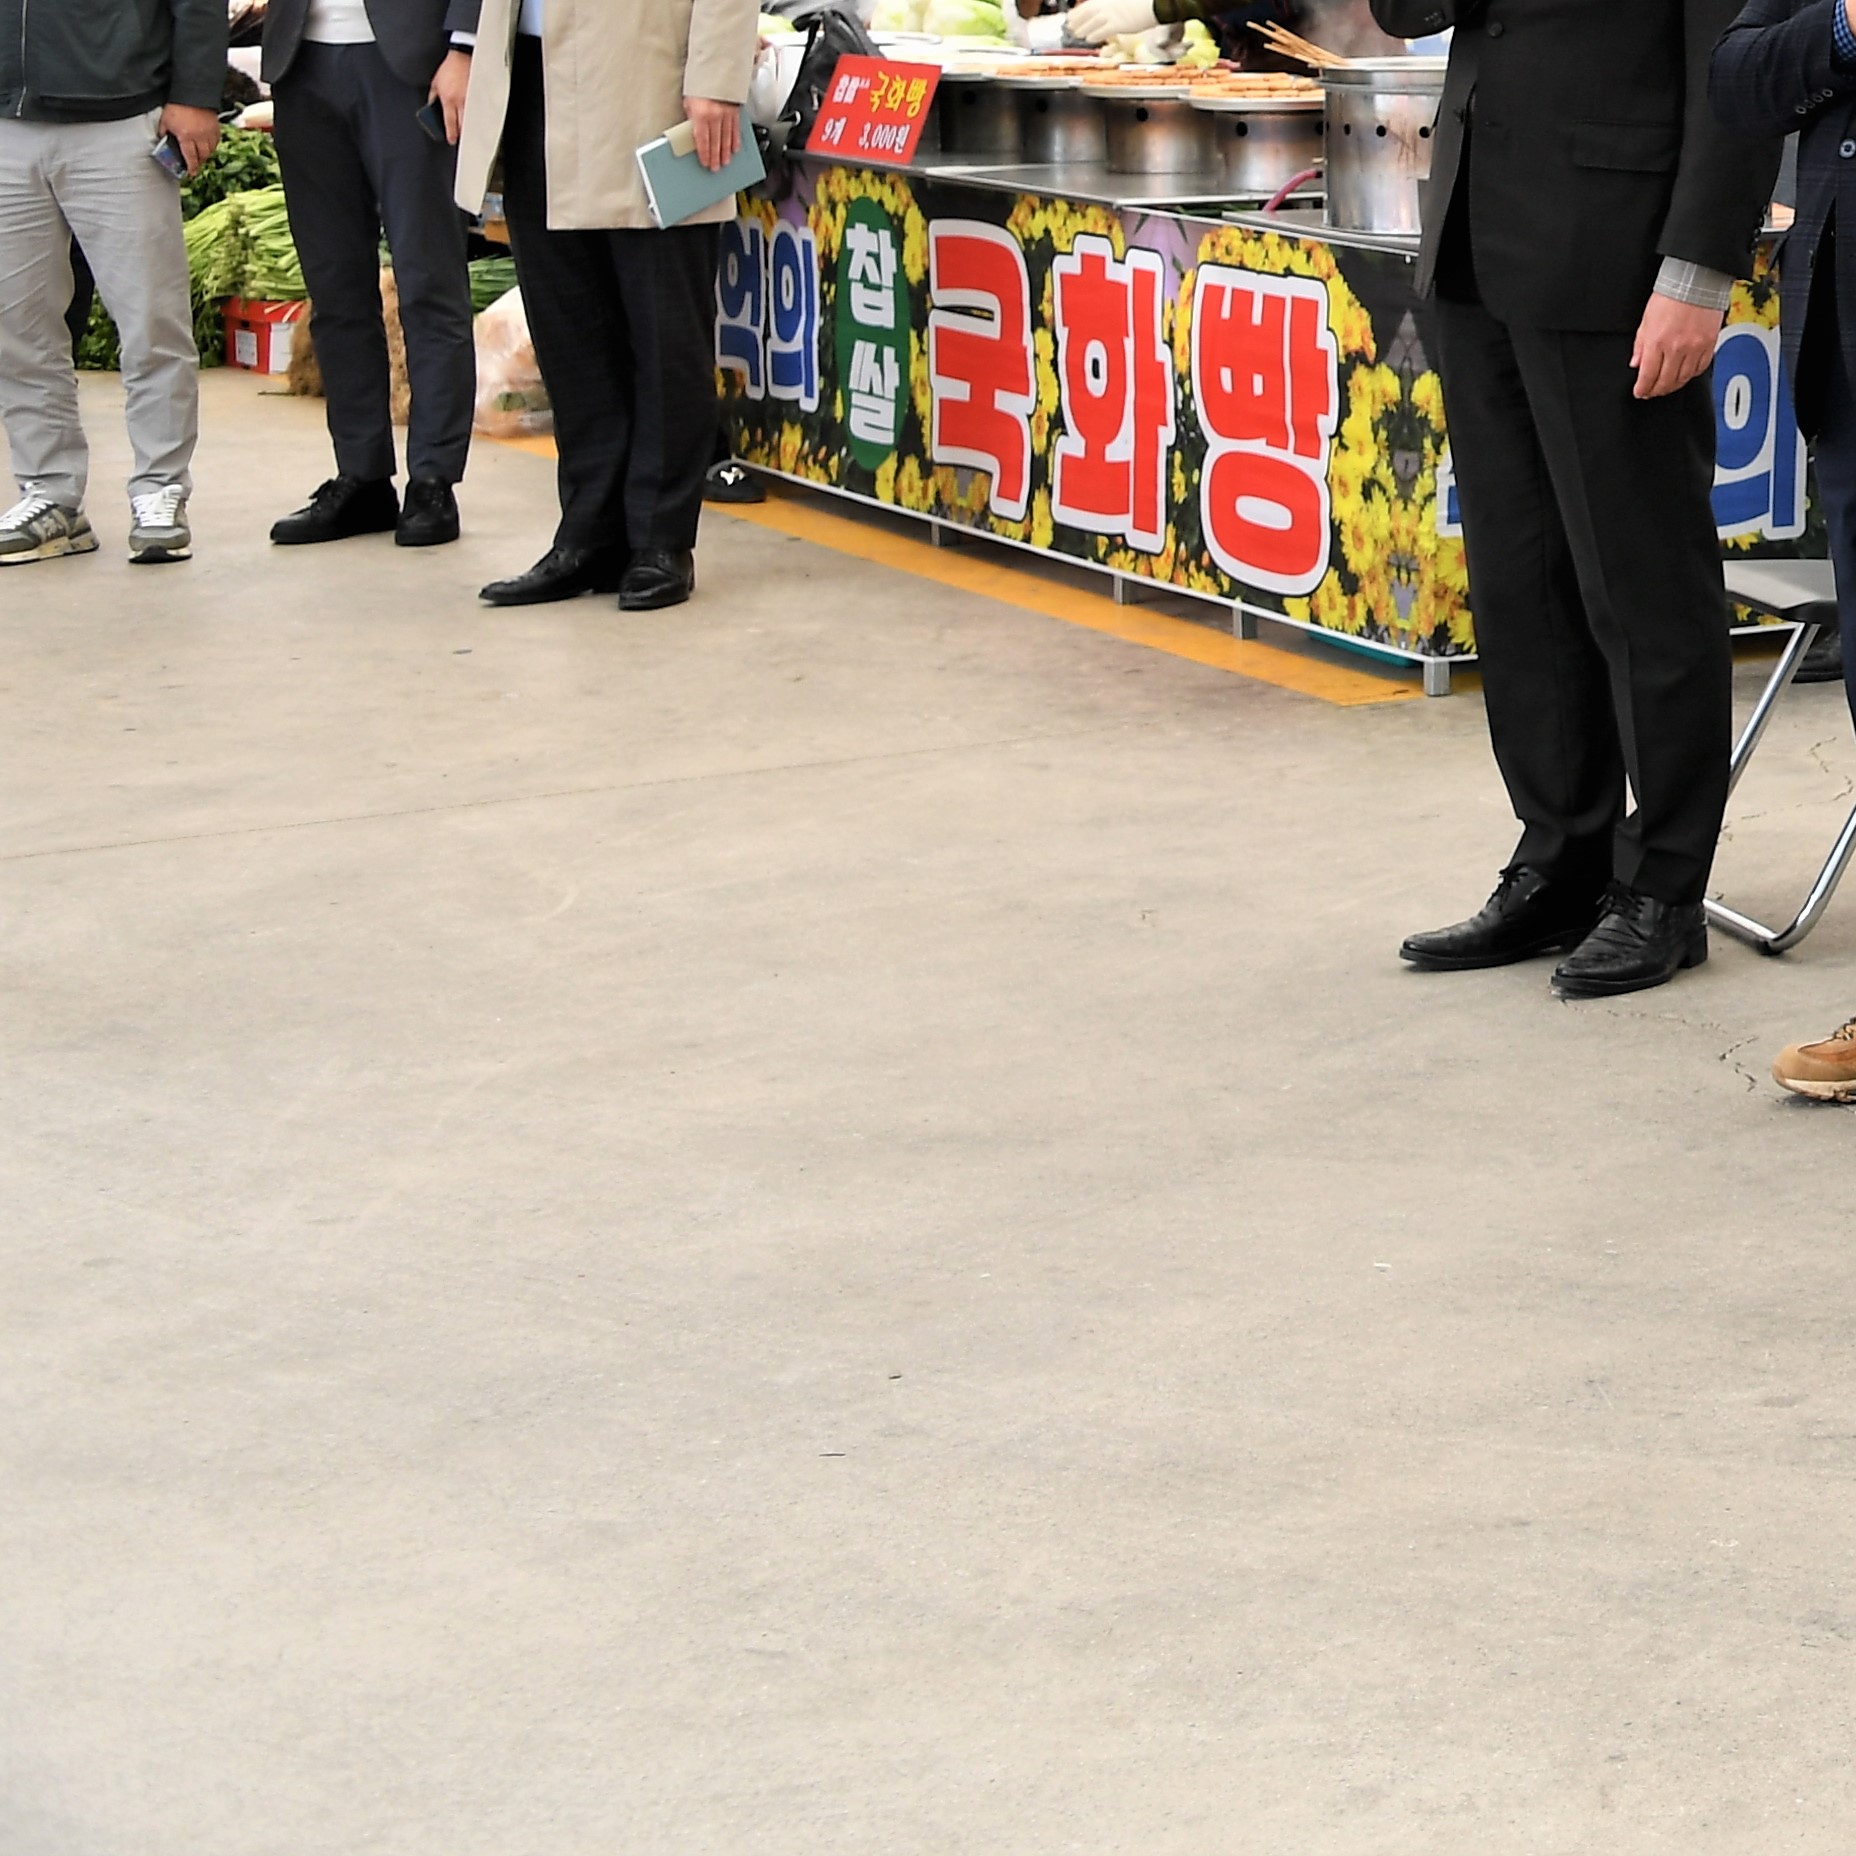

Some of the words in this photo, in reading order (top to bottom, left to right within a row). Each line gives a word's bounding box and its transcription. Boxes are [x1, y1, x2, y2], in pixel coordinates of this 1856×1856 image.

[870, 70, 928, 119] 국화빵
[845, 219, 900, 447] 찹쌀
[928, 217, 1339, 597] 국화빵
